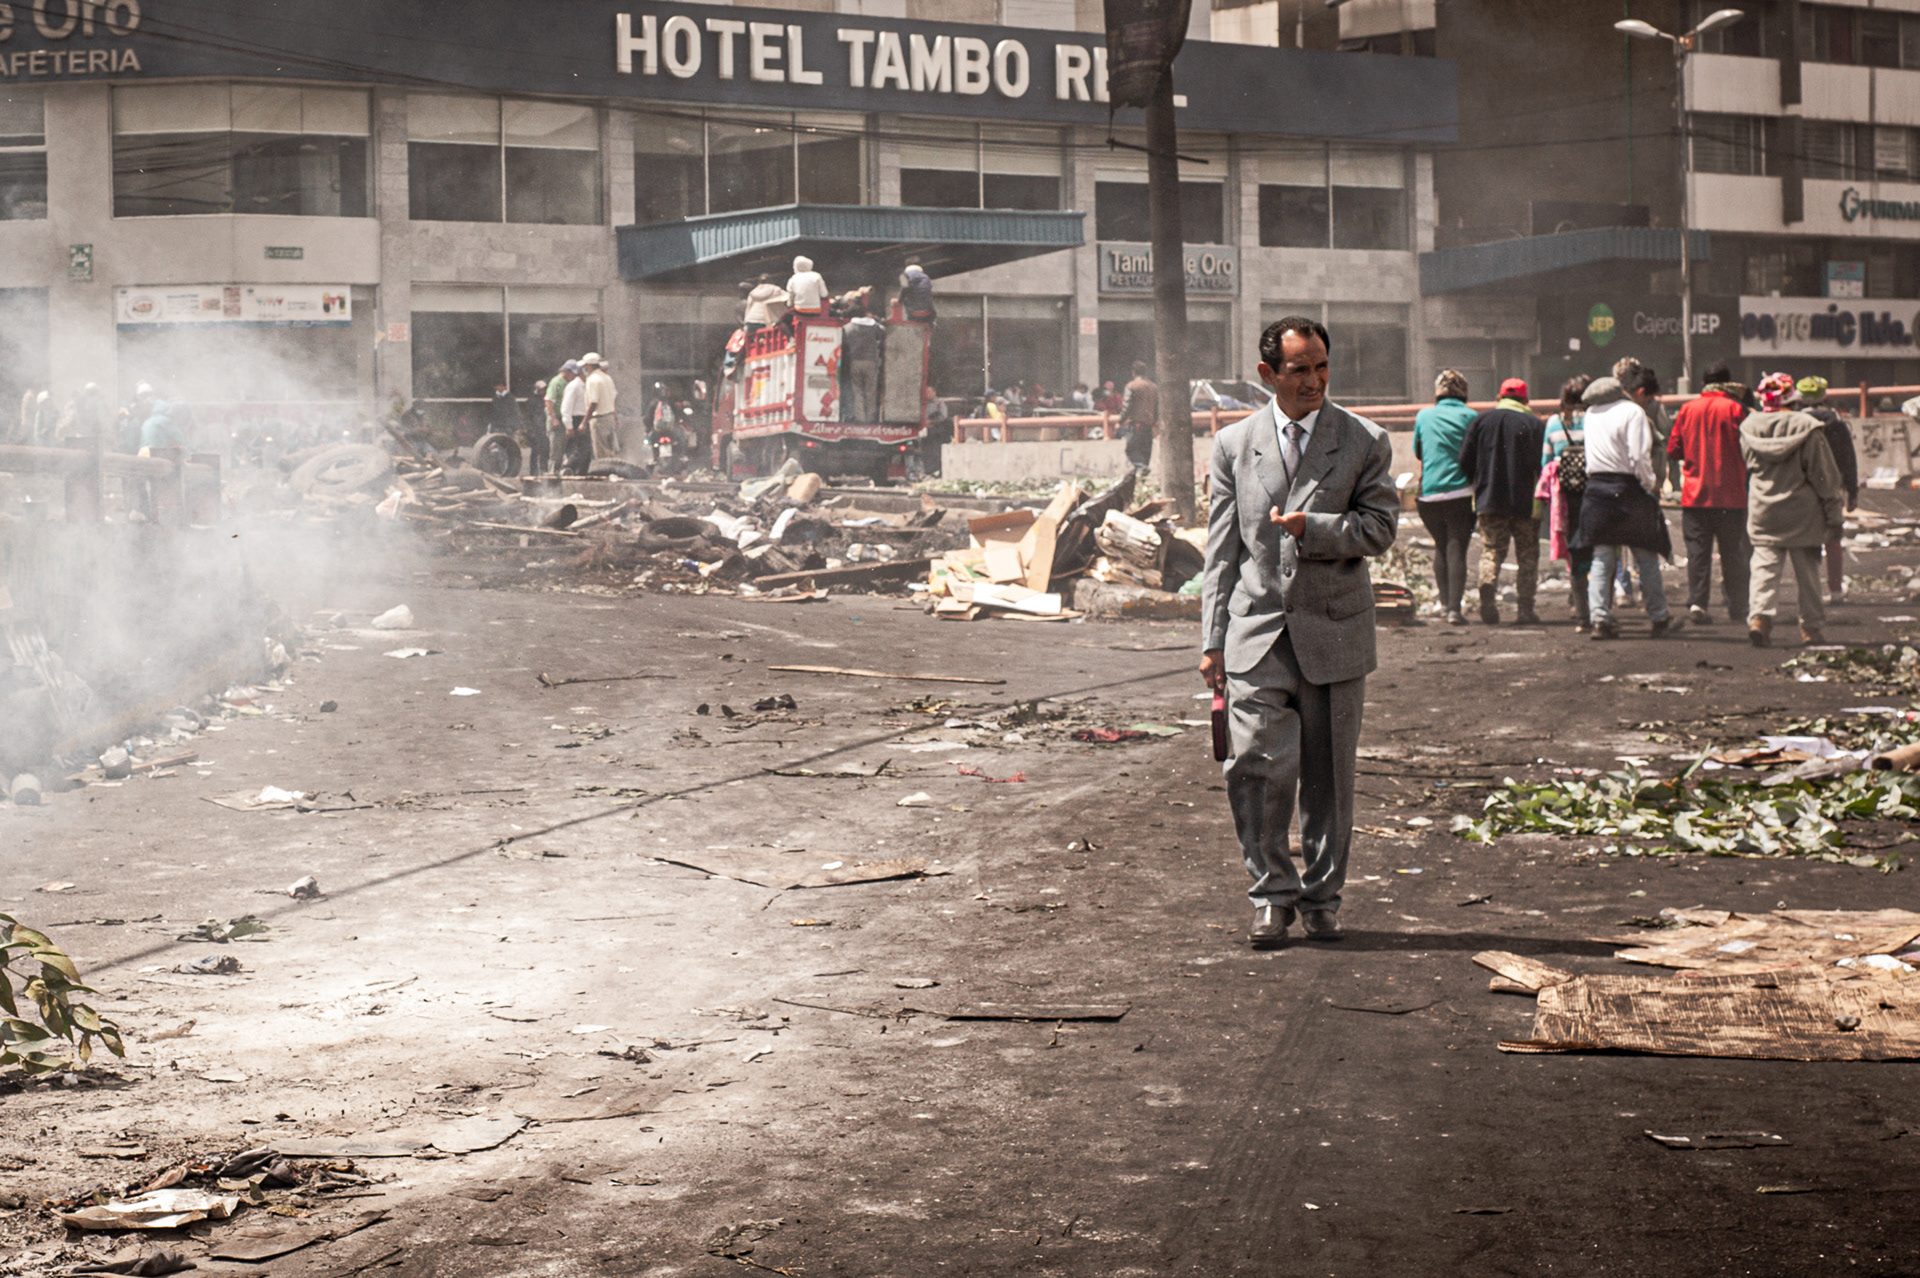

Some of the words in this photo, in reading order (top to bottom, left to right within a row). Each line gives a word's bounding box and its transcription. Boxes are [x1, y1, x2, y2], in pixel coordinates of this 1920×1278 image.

[33, 0, 141, 40] Oro
[616, 13, 823, 85] HOTEL
[837, 28, 1030, 98] TAMBO
[1055, 44, 1188, 107] RE
[1109, 250, 1154, 273] Tam
[1201, 253, 1234, 275] Oro
[1588, 316, 1615, 332] JEP
[1633, 311, 1684, 339] Cajero
[1689, 313, 1721, 334] JEP
